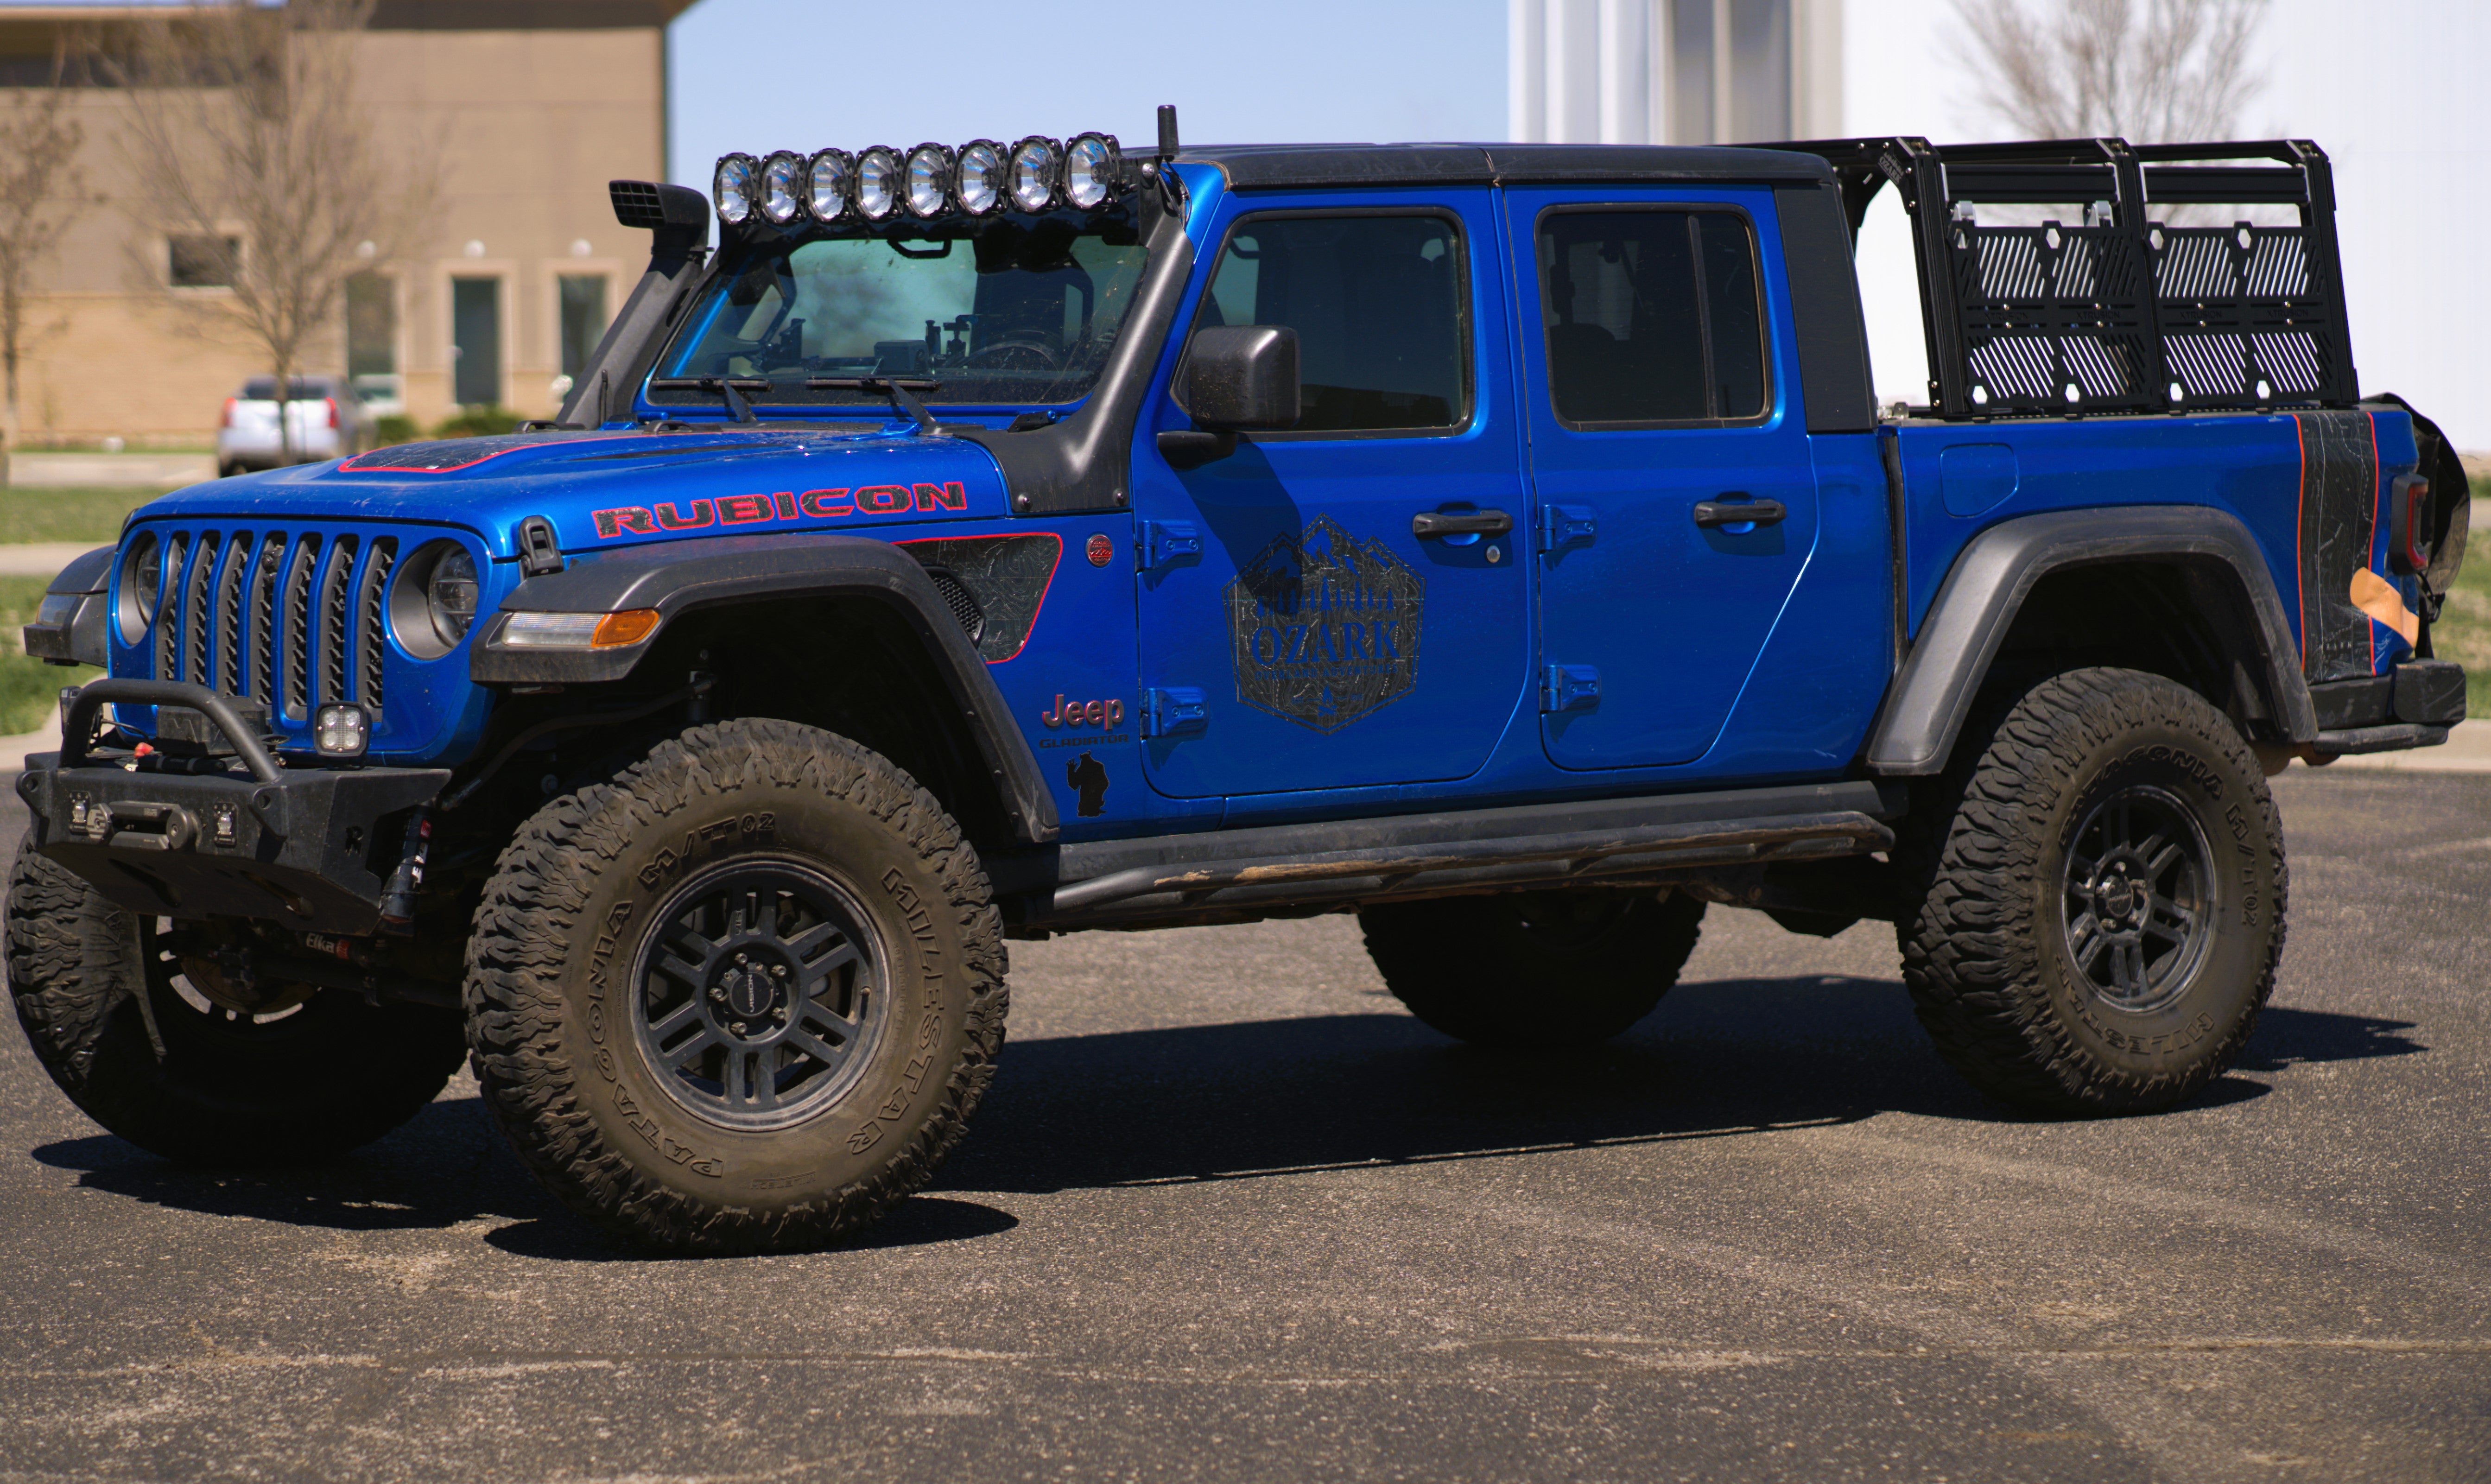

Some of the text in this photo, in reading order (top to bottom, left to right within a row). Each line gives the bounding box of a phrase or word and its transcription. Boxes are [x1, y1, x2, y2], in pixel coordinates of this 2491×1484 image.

[591, 481, 968, 539] RUBICON
[1252, 621, 1401, 666] OZARK
[1255, 664, 1398, 681] OVERLAND ADVENTURES
[1042, 694, 1125, 731] Jeep
[1039, 733, 1129, 749] GLADIATOR
[306, 932, 335, 954] Elka
[846, 867, 944, 1155] MILESTAR
[2054, 953, 2215, 1056] MILESTAR
[587, 900, 723, 1178] PATAGONIA
